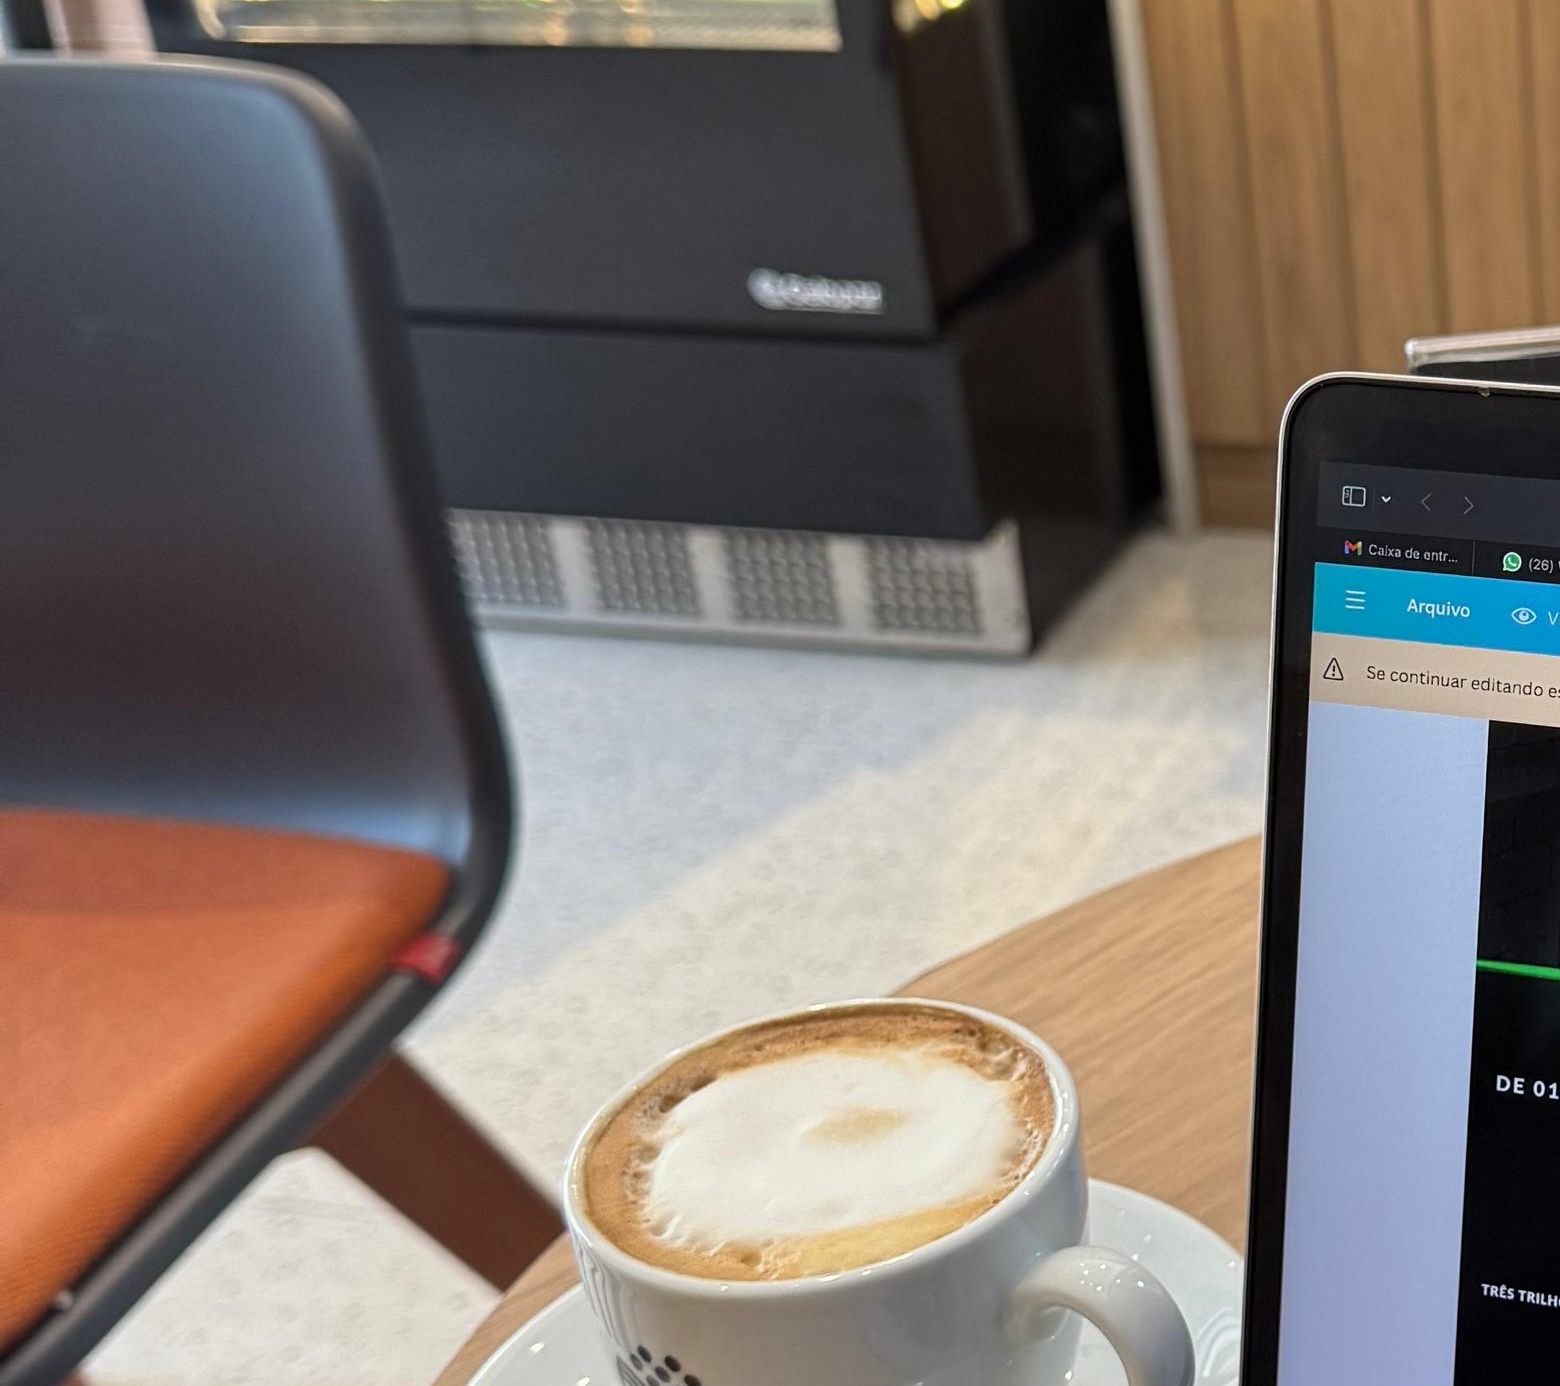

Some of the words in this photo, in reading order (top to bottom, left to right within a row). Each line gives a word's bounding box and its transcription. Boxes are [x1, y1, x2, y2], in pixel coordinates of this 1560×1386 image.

[1368, 543, 1402, 559] Caixa
[1404, 546, 1420, 561] de
[1528, 557, 1554, 575] (26)
[1406, 597, 1471, 620] Arquivo
[1366, 664, 1386, 682] Se
[1389, 669, 1468, 689] continuar
[1471, 677, 1544, 698] editando
[1496, 1073, 1525, 1096] DE
[1481, 1282, 1515, 1301] TRÊS
